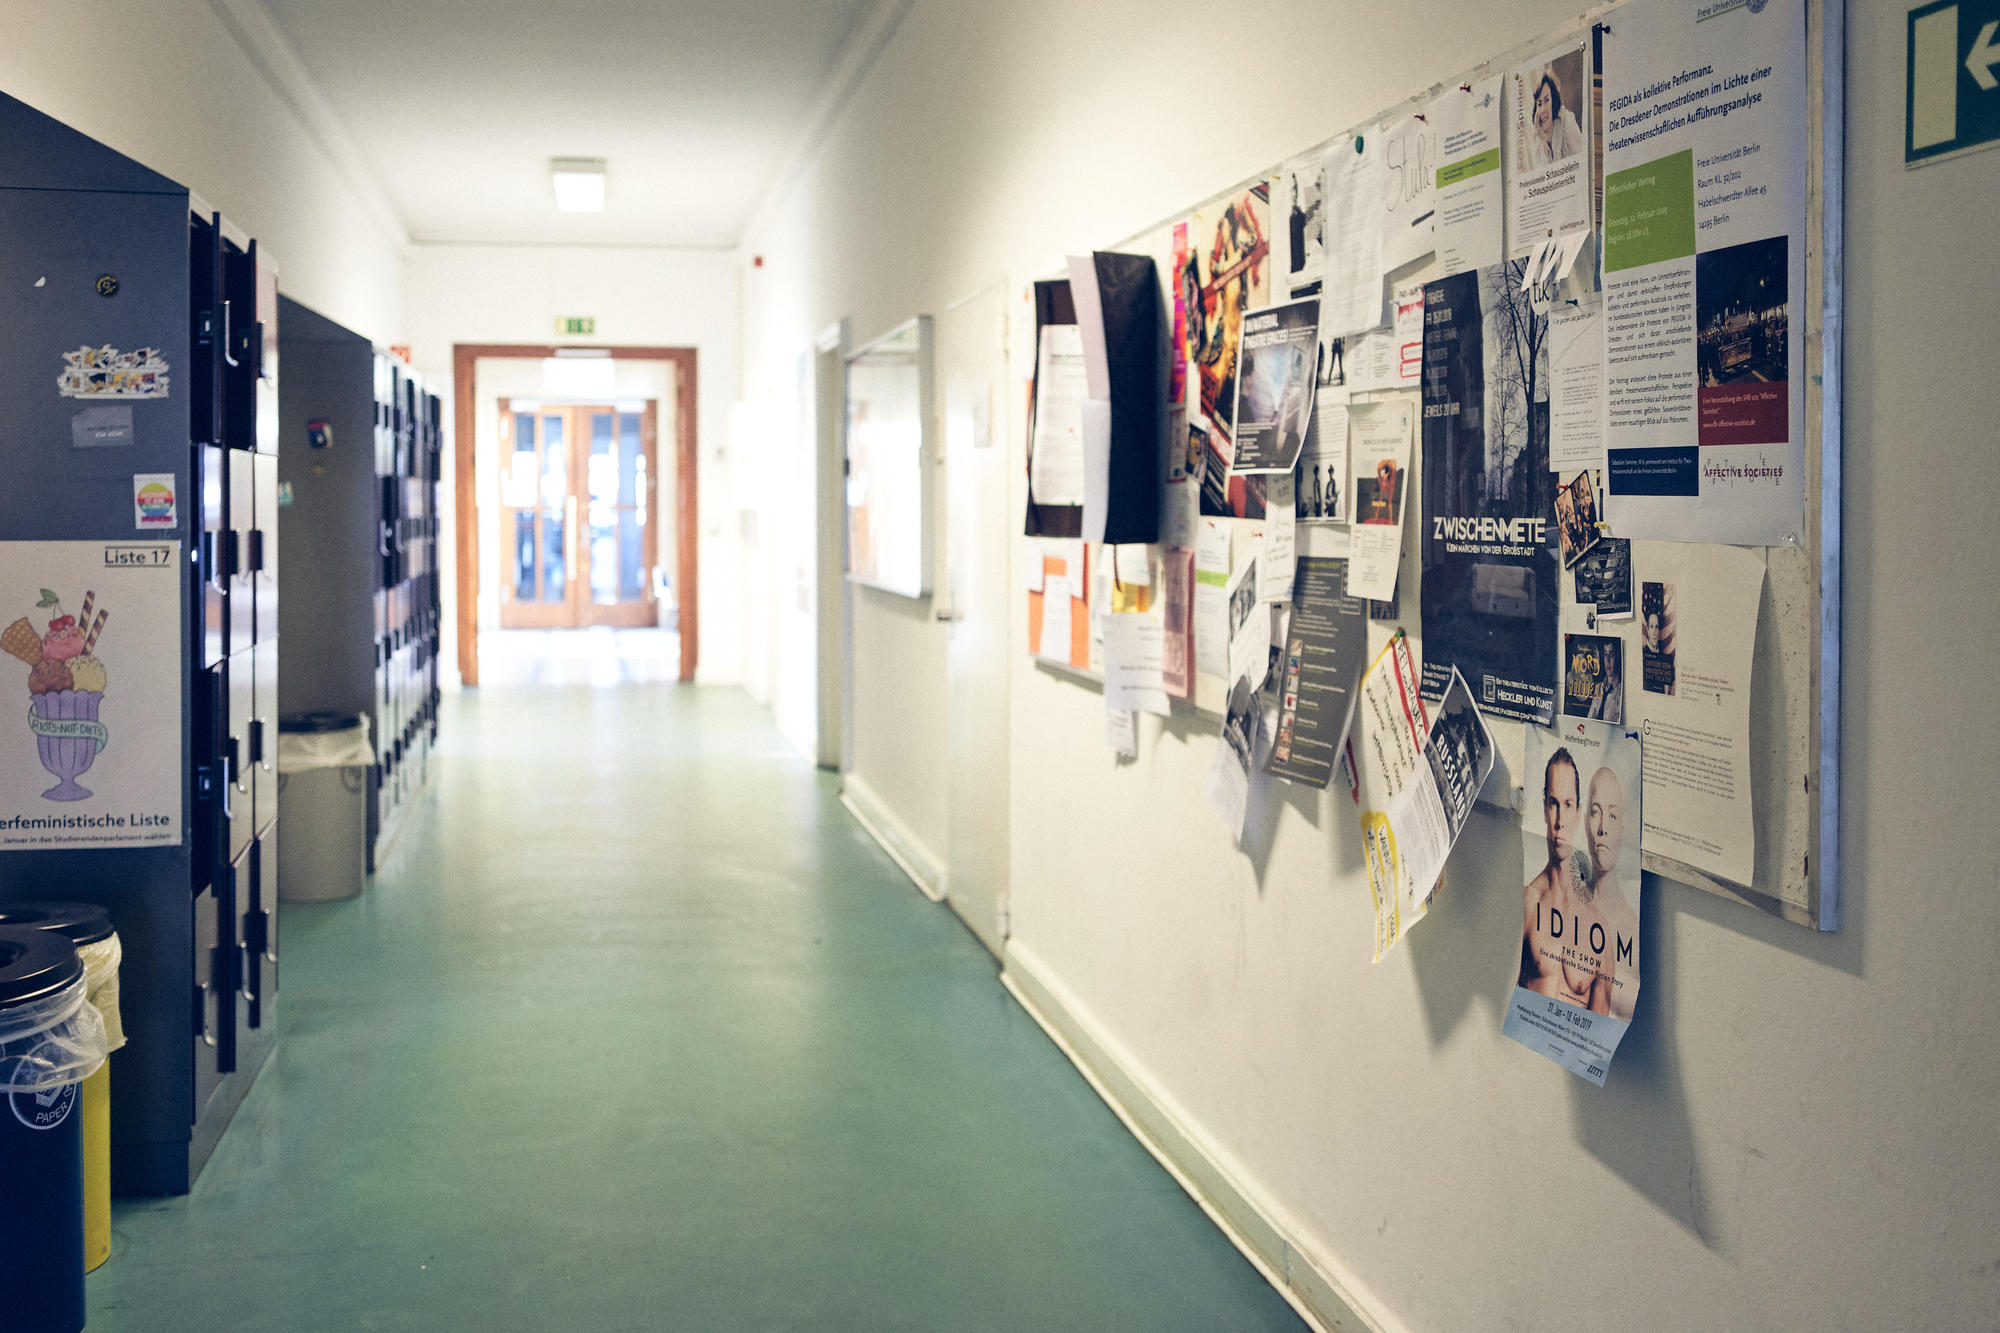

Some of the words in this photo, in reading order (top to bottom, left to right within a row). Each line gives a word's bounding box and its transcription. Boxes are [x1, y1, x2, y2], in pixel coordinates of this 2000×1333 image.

[1609, 93, 1633, 113] PEGIDA
[1633, 90, 1642, 104] als
[1643, 79, 1671, 100] kollektive
[1672, 65, 1714, 86] Performanz.
[1609, 120, 1619, 133] Die
[1620, 108, 1652, 128] Dresdener
[1653, 86, 1710, 116] Demonstrationen
[1711, 82, 1722, 95] im
[1723, 74, 1749, 91] Lichte
[1750, 66, 1772, 83] einer
[1608, 116, 1686, 152] theaterwissenschaftlichen
[1686, 91, 1762, 127] Aufführungsanalyse
[1696, 158, 1711, 170] Freie
[1710, 150, 1742, 166] Universität
[1742, 143, 1761, 157] Berlin
[1697, 176, 1713, 189] Raum
[1714, 174, 1722, 186] KL
[1698, 190, 1744, 208] Habelschwerdter
[1744, 186, 1759, 197] Allee
[1713, 214, 1730, 226] Berlin
[1704, 468, 1742, 478] AFFECTIVE
[1744, 468, 1783, 478] SOCIETIES
[104, 549, 146, 564] Liste
[152, 549, 170, 564] 17
[1481, 545, 1492, 554] VON
[1492, 545, 1502, 555] DER
[1572, 654, 1600, 676] MORD
[1497, 689, 1524, 705] HECKLER
[1524, 695, 1536, 707] UND
[1535, 697, 1553, 711] KUNST
[1436, 733, 1466, 820] RUSSLAND
[130, 813, 170, 827] Liste
[3, 836, 28, 844] Januar
[30, 836, 37, 844] in
[1536, 902, 1633, 968] IDIOM
[1539, 948, 1549, 958] Eine
[1611, 976, 1624, 989] Story
[1562, 946, 1575, 959] THE
[1579, 952, 1602, 969] SHOW
[35, 1101, 68, 1124] PAPER
